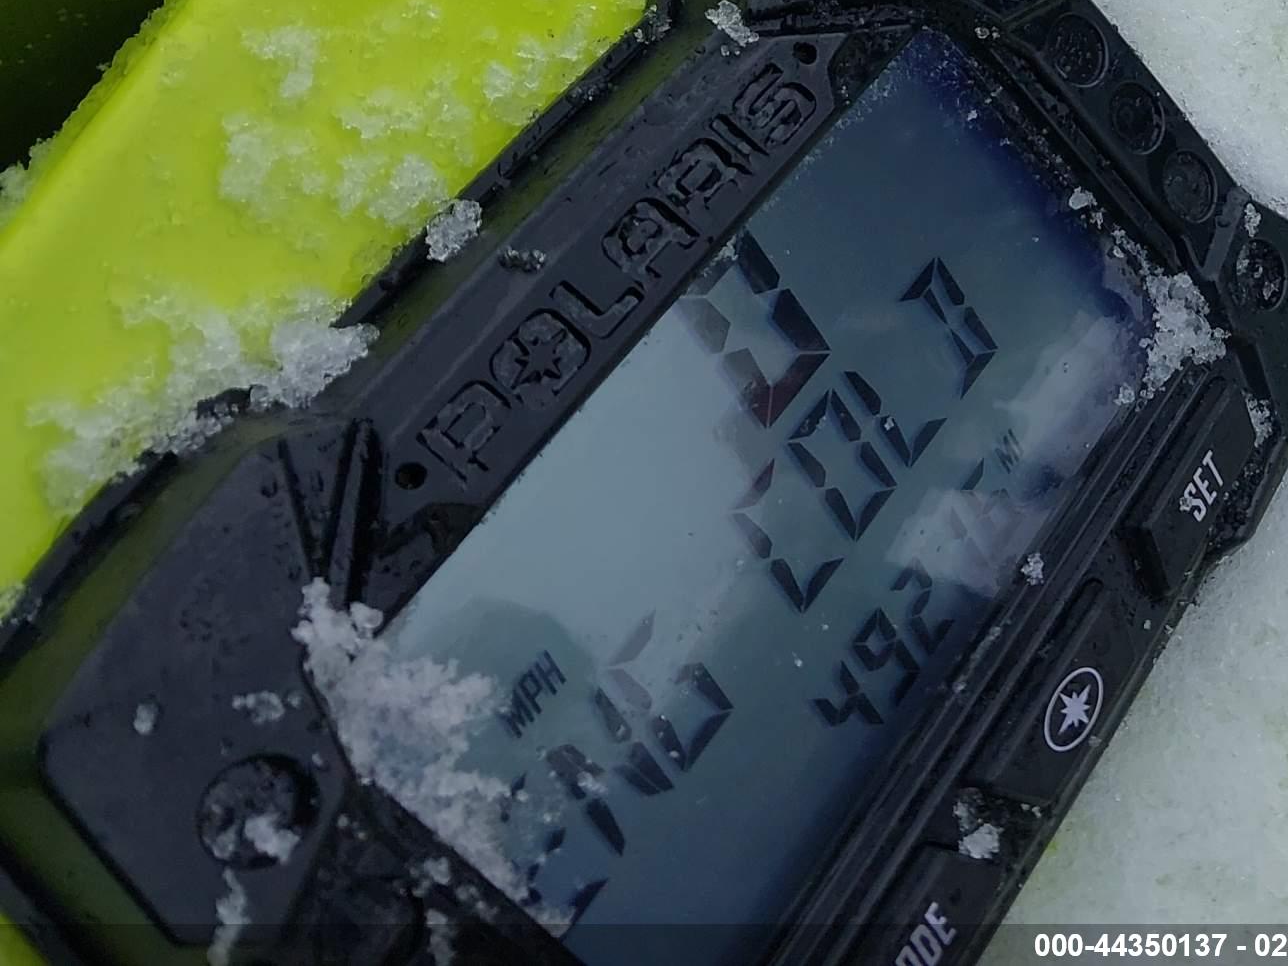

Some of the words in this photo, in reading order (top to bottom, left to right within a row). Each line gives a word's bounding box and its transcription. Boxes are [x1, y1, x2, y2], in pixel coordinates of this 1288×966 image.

[416, 62, 817, 490] POLARIS
[728, 256, 998, 614] COLD
[1182, 449, 1223, 522] SET
[502, 649, 566, 738] MPH
